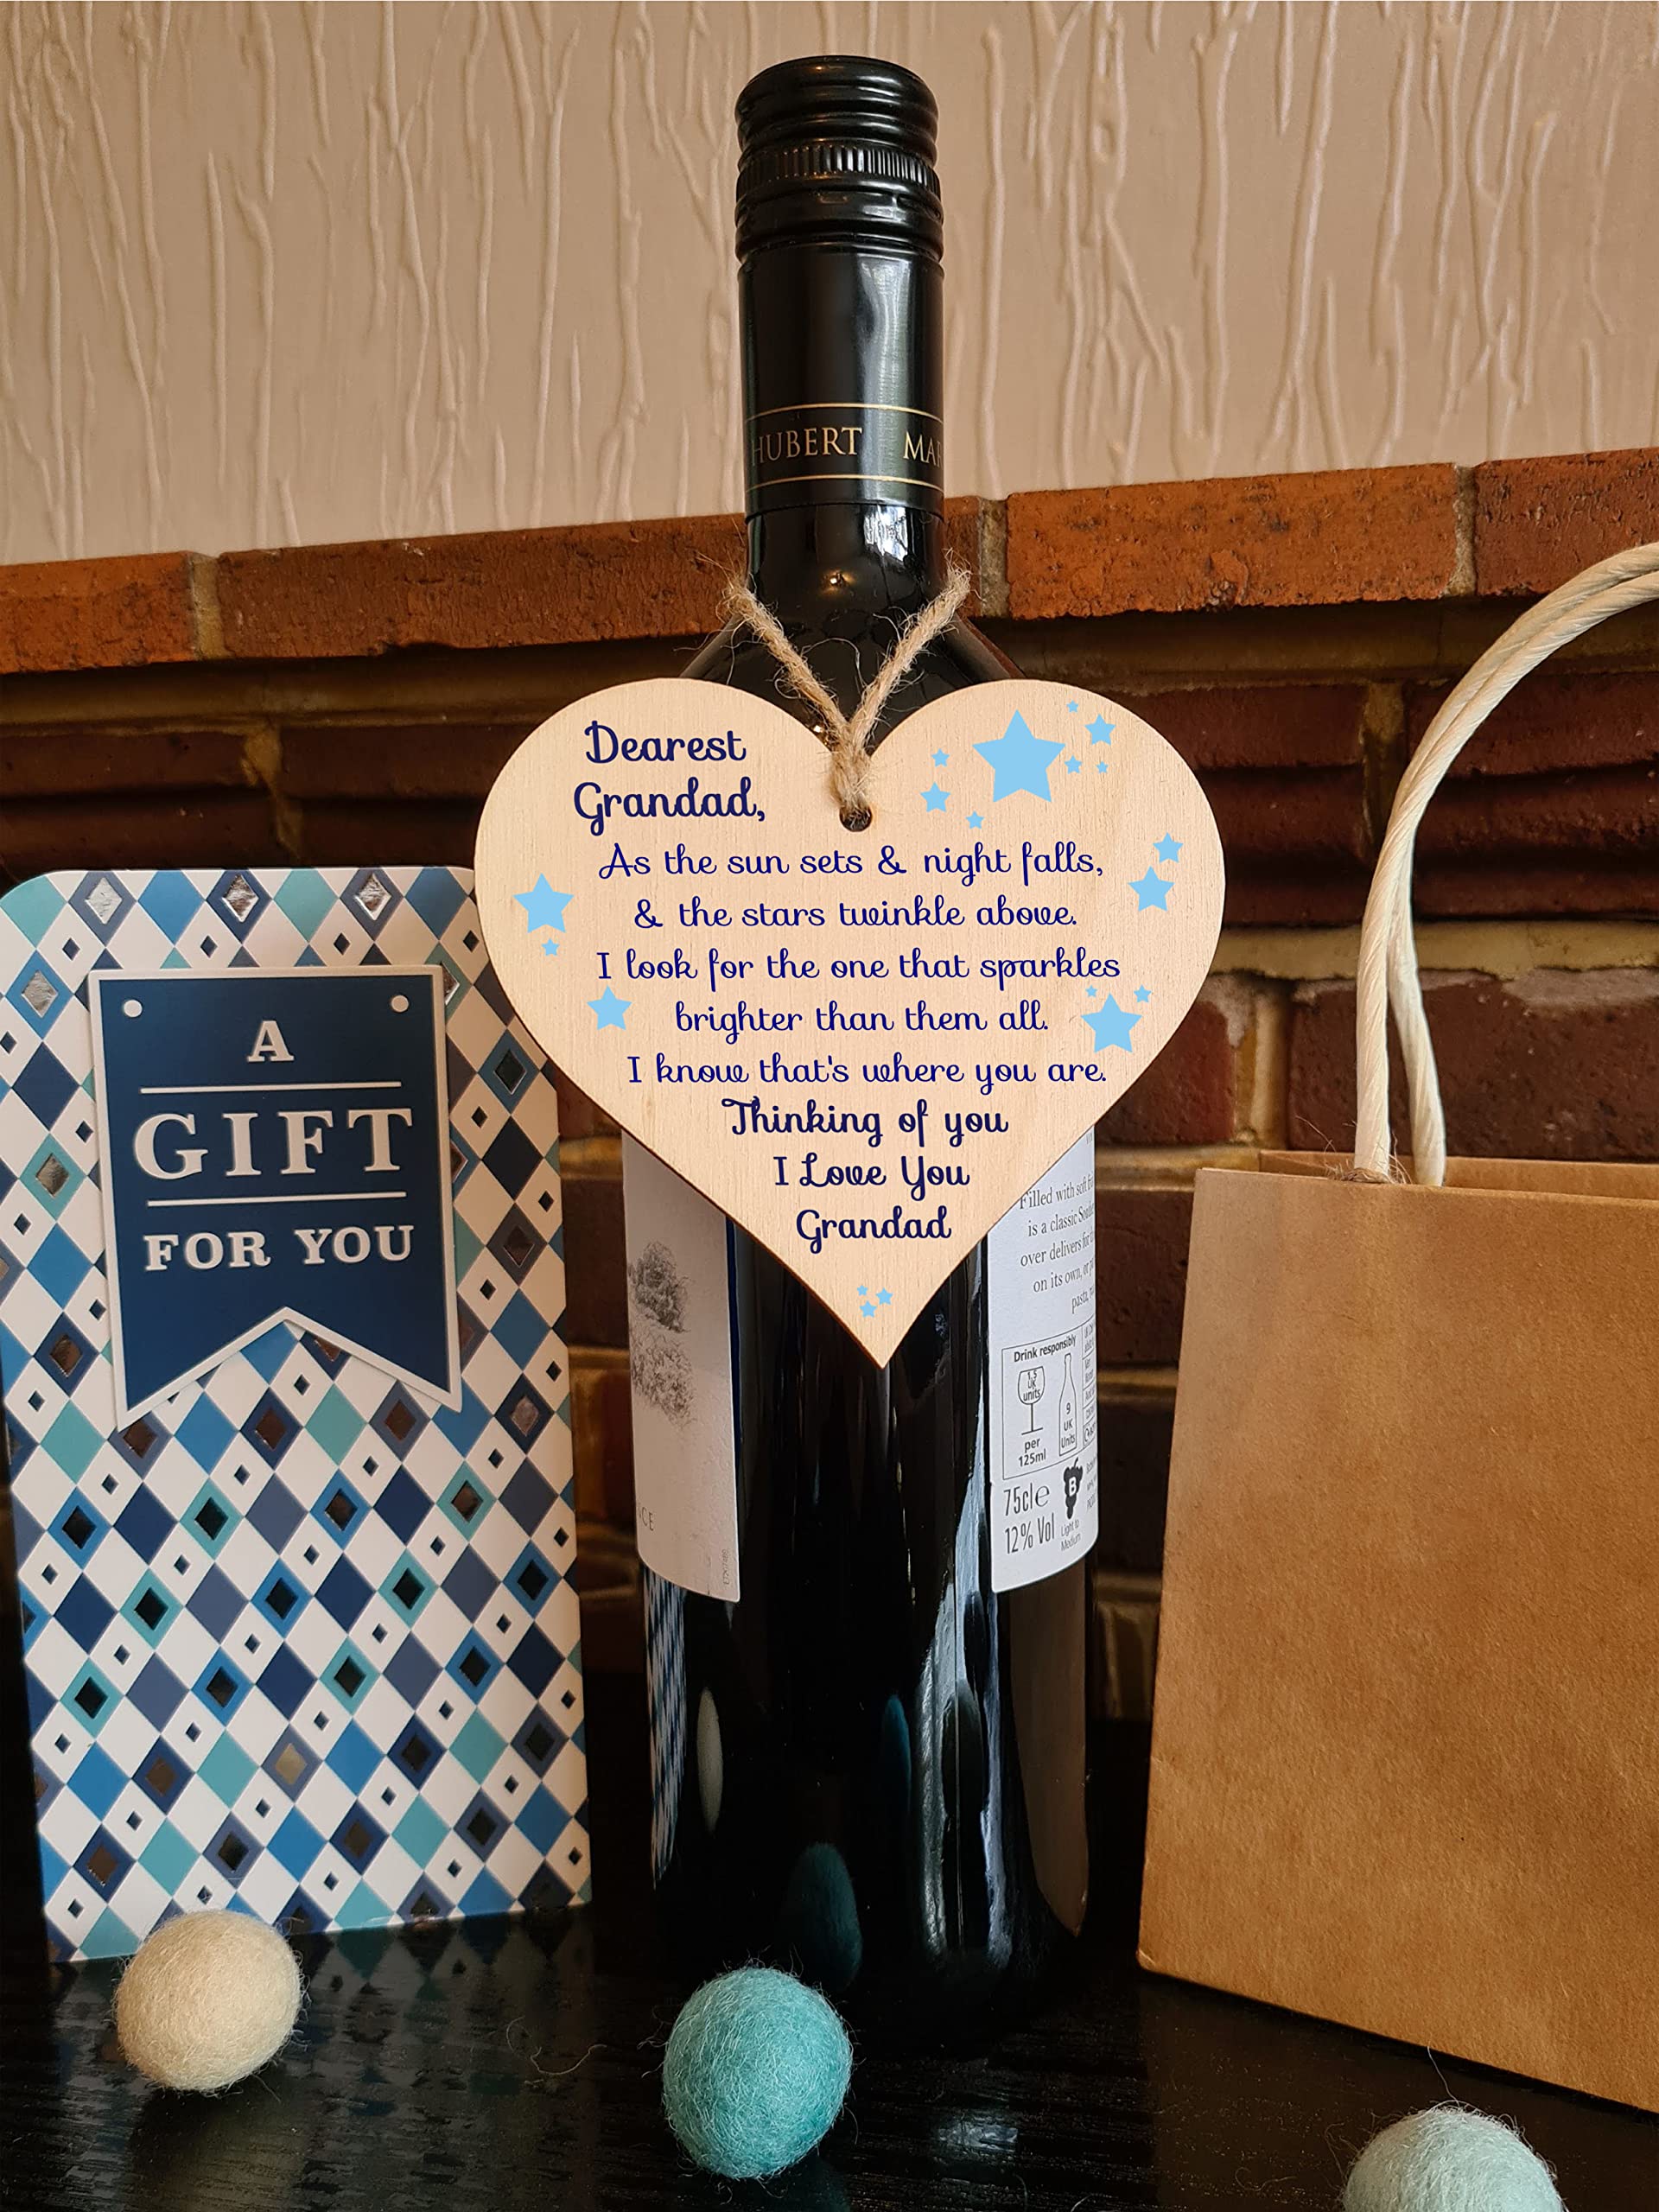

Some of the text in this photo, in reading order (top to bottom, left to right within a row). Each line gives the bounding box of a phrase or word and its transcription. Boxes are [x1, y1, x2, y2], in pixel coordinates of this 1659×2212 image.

[753, 427, 862, 466] HUBERT
[585, 721, 746, 763] Dearest
[575, 777, 765, 836] Grandad,
[599, 842, 1103, 887] As the sun sets & night falls,
[635, 894, 1077, 928] & the stars twinkle above.
[597, 947, 1120, 992] I look for the one that sparkles
[247, 1020, 295, 1063] A
[676, 1000, 1047, 1045] brighter than them all.
[627, 1052, 1106, 1095] I know that's where you are.
[721, 1096, 1008, 1147] Thinking of you
[133, 1108, 413, 1180] GIFT
[774, 1153, 969, 1201] I Love You
[1056, 1182, 1074, 1202] with
[797, 1206, 951, 1254] Grandad
[1028, 1220, 1038, 1236] is
[1041, 1224, 1047, 1234] a
[1050, 1211, 1077, 1231] classic
[143, 1225, 415, 1272] FOR YOU
[1020, 1249, 1046, 1267] over
[1049, 1239, 1082, 1261] delivers
[1033, 1278, 1047, 1292] on
[1051, 1272, 1062, 1288] its
[1065, 1268, 1082, 1284] own,
[1014, 1347, 1037, 1362] Drink
[1039, 1334, 1076, 1357] responsibly
[1023, 1389, 1040, 1402] units
[1066, 1402, 1071, 1414] 9
[1061, 1433, 1075, 1448] Units
[1064, 1419, 1073, 1431] UK
[1018, 1448, 1046, 1467] 125ml
[1025, 1438, 1040, 1453] per
[1069, 1476, 1077, 1497] B
[1005, 1512, 1055, 1554] 12% Vol
